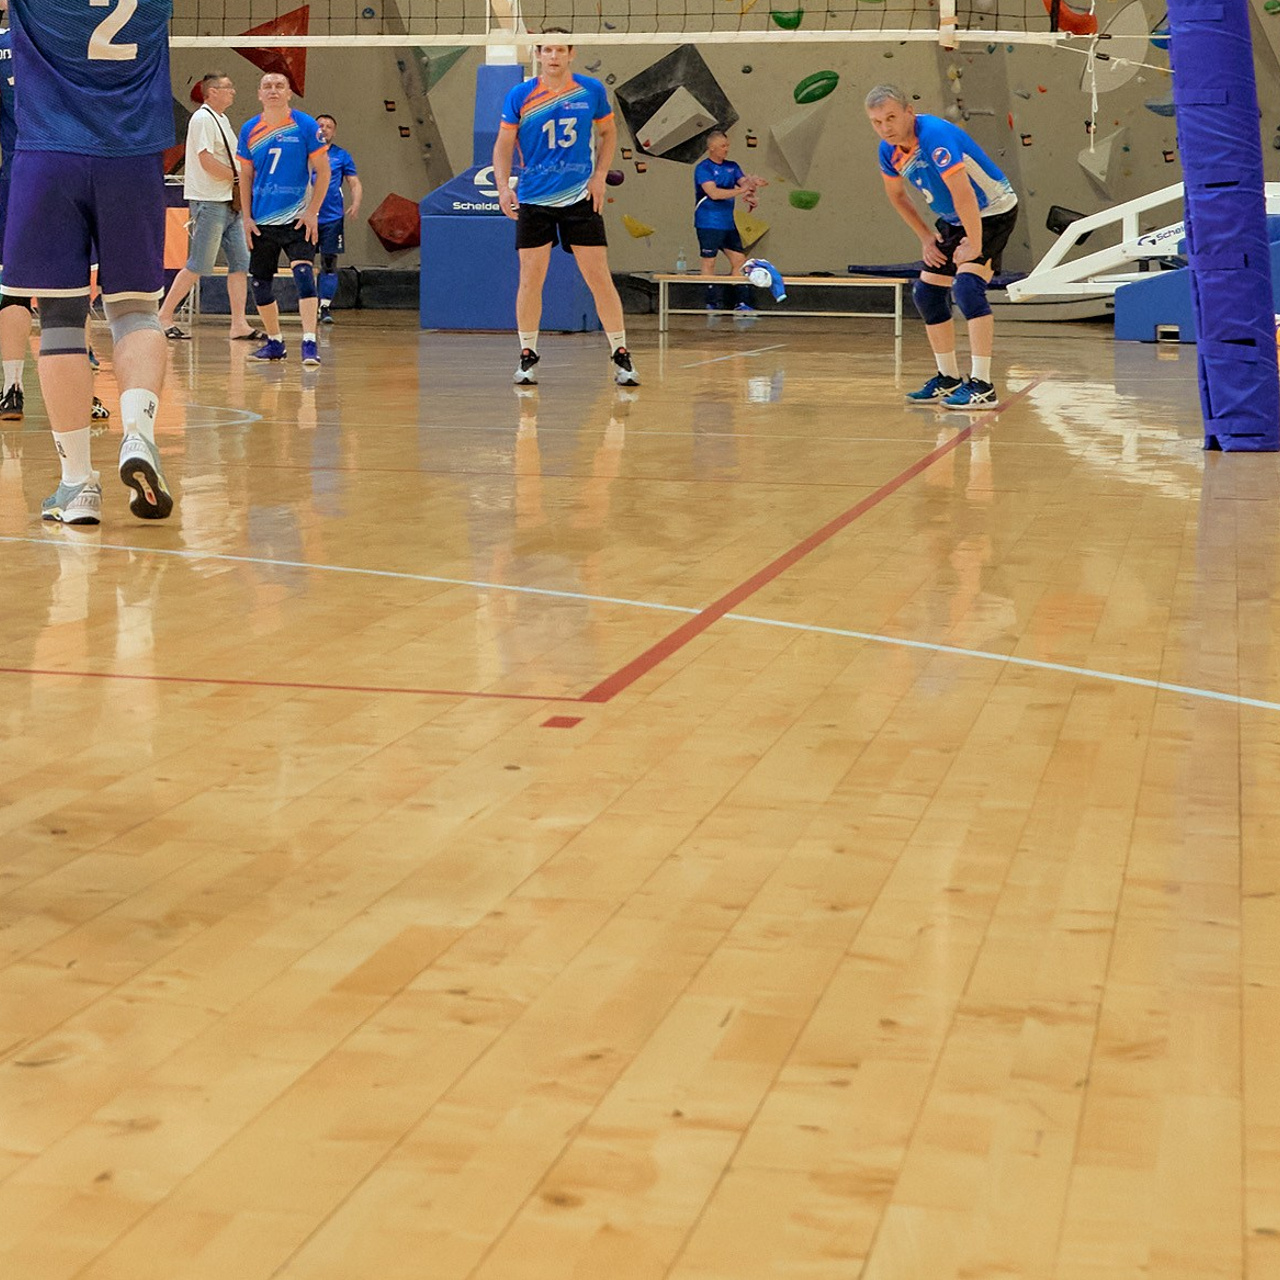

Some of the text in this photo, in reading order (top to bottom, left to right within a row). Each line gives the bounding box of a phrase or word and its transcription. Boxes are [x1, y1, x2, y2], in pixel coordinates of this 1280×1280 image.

[542, 117, 578, 149] 13
[268, 147, 282, 174] 7
[452, 201, 500, 211] Schelde
